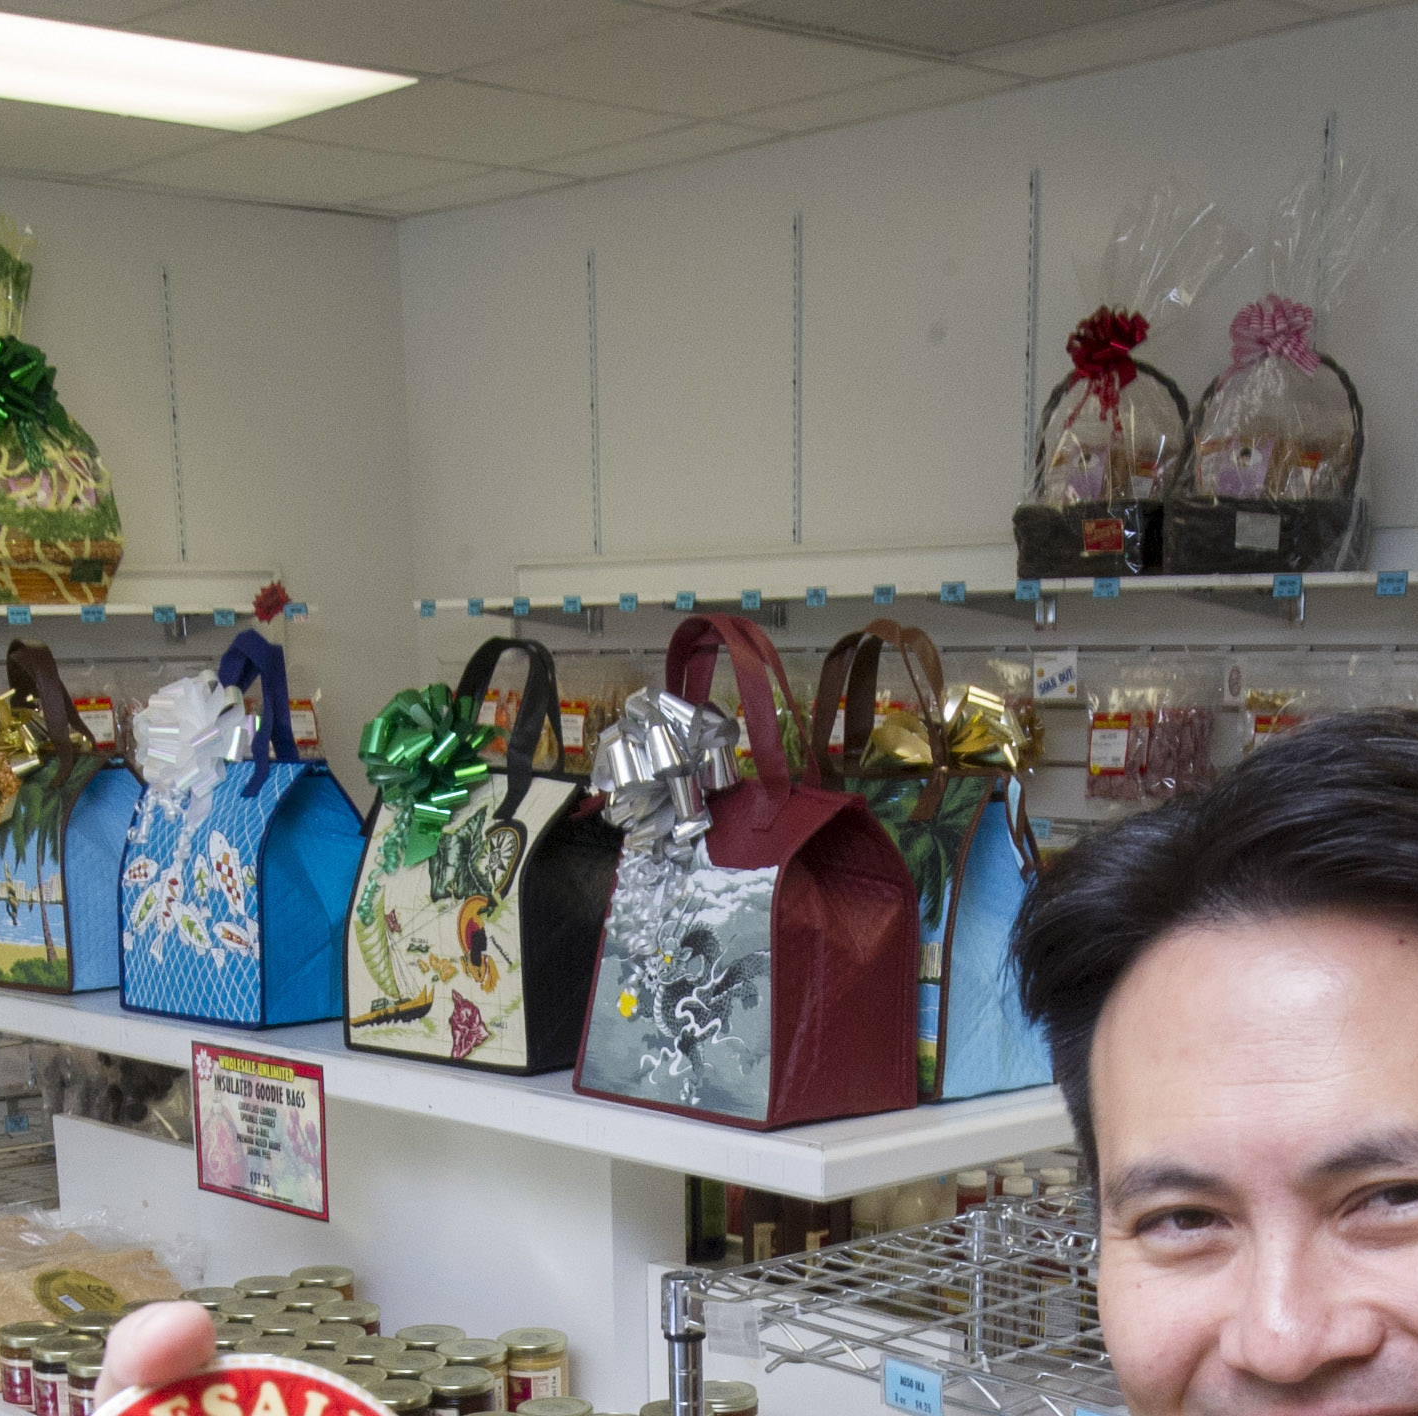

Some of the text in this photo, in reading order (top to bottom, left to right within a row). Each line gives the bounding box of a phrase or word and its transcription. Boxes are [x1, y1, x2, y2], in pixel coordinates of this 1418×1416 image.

[1038, 668, 1075, 695] SOLD OUT
[218, 1056, 295, 1082] WHOLESALE UNLIMITED
[214, 1074, 306, 1109] INSULATED GOODIE BAGS
[900, 1375, 925, 1393] MISO IKA
